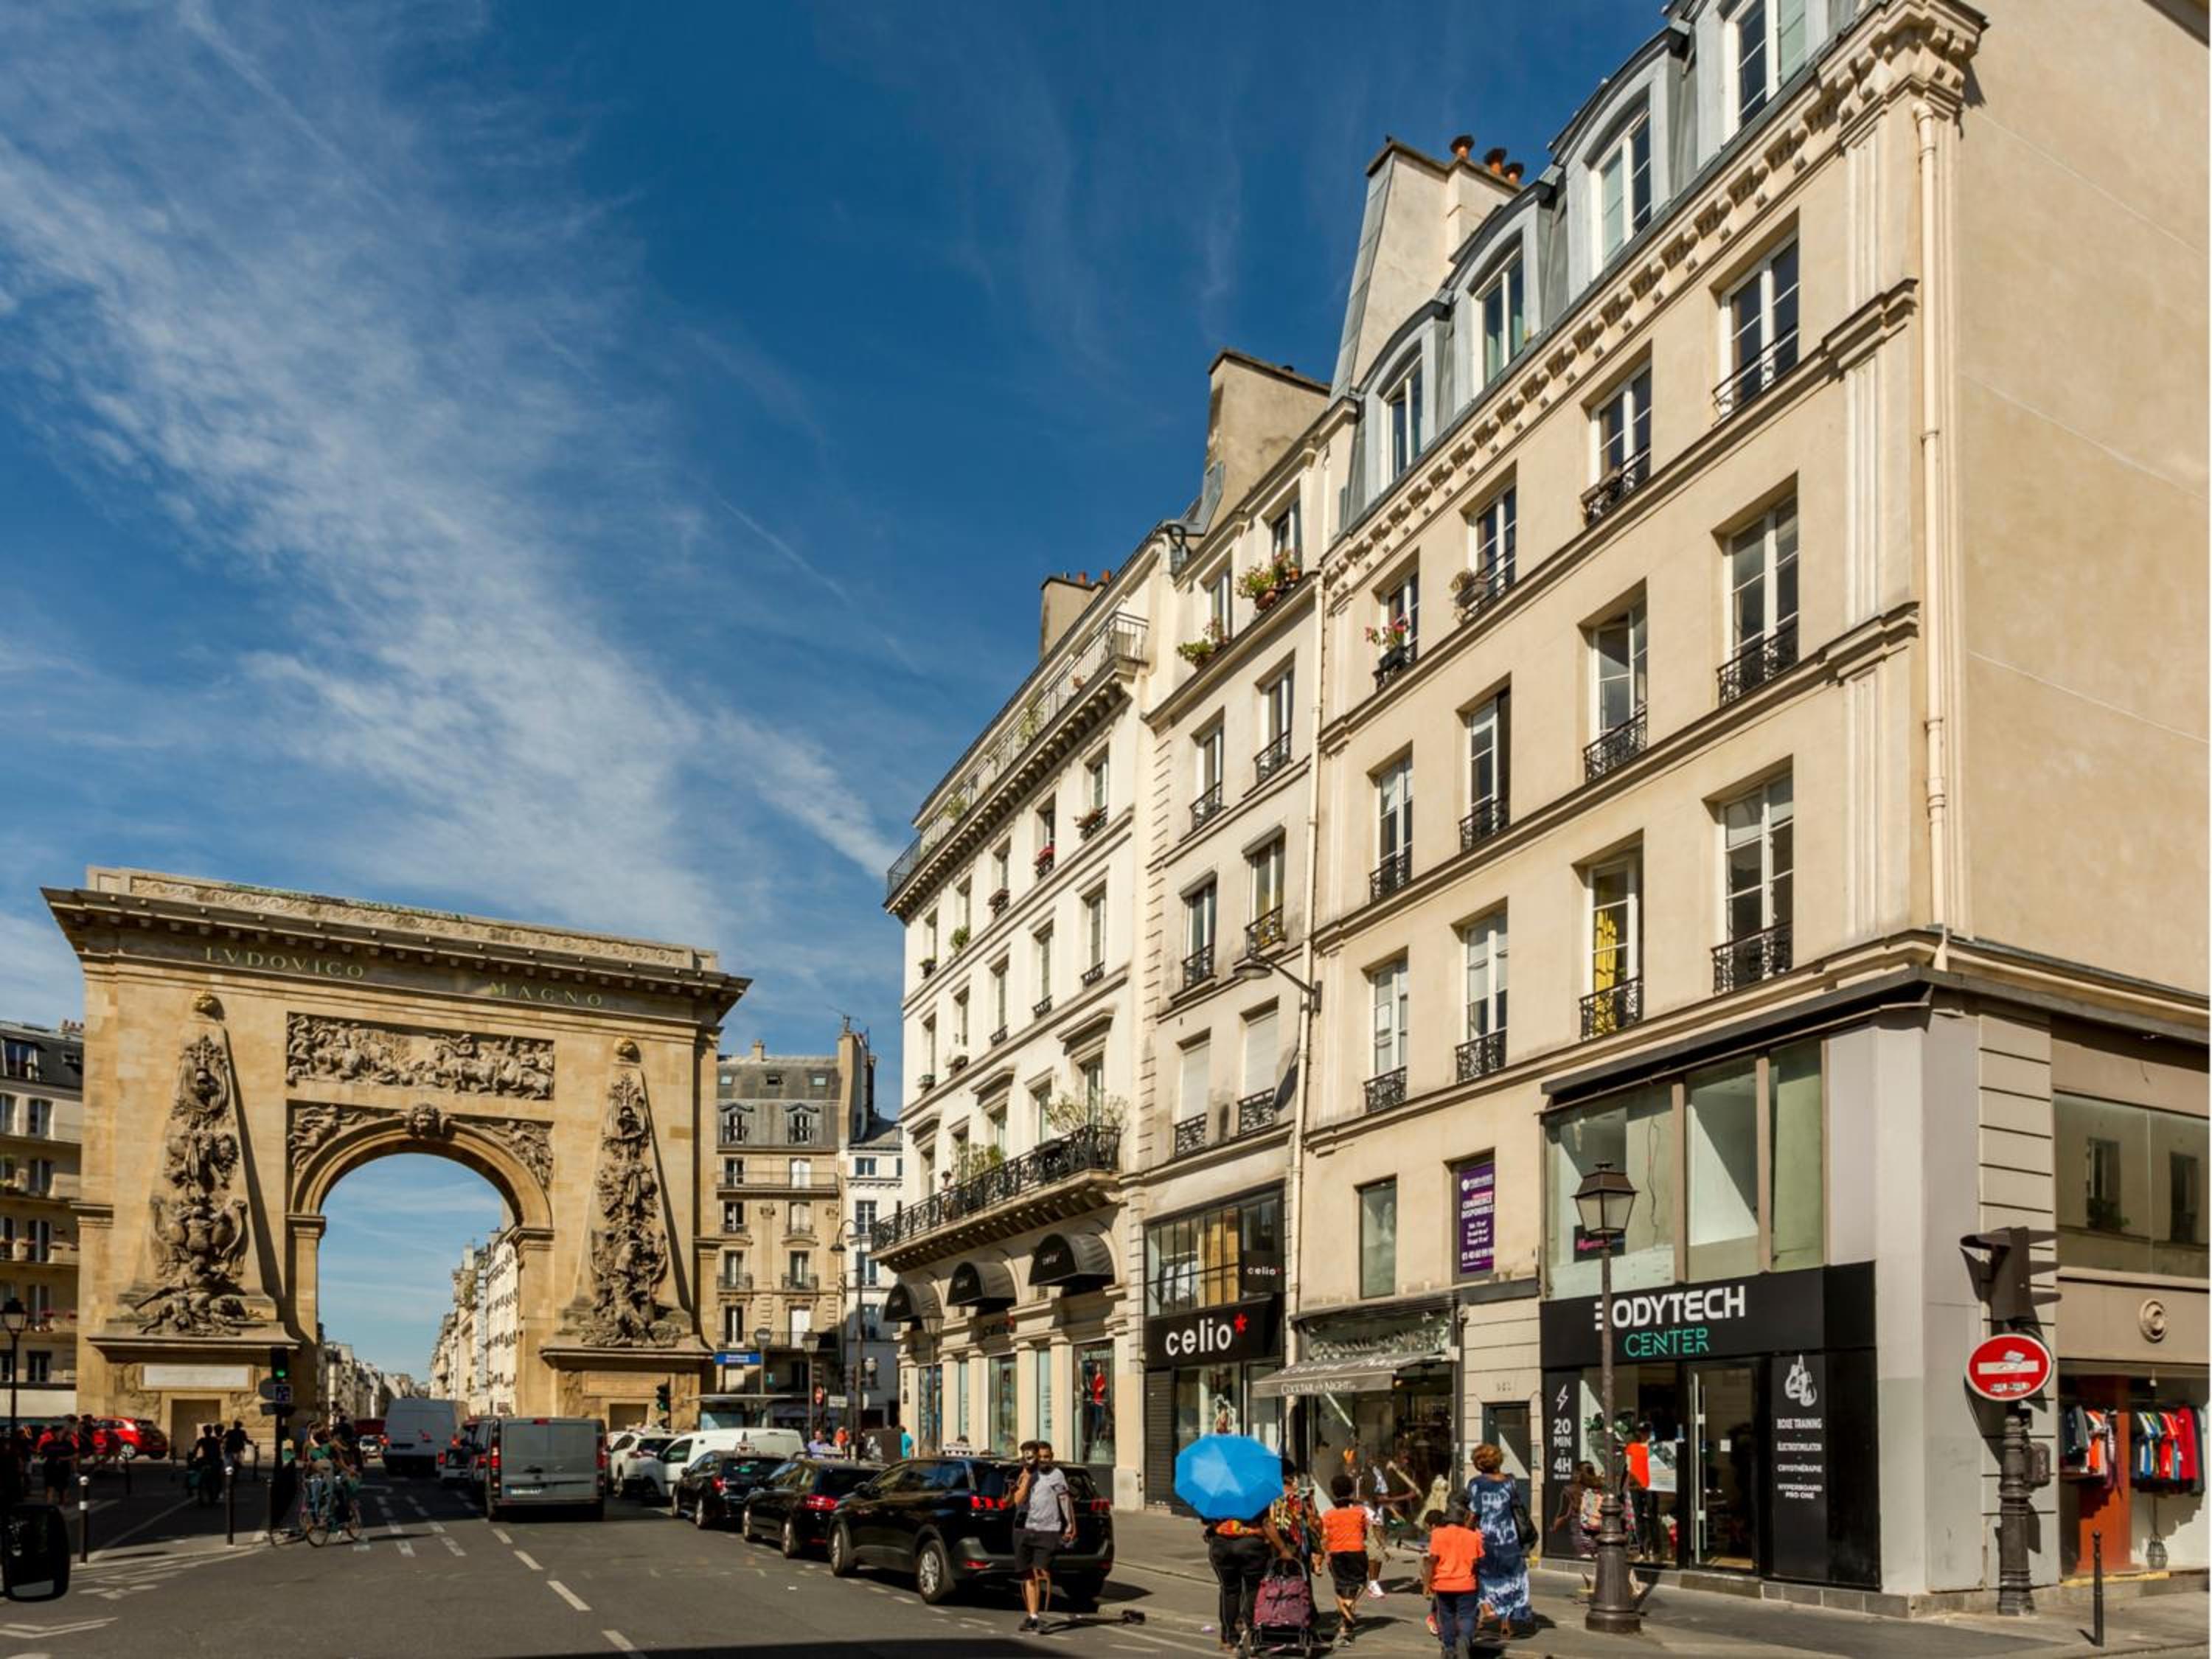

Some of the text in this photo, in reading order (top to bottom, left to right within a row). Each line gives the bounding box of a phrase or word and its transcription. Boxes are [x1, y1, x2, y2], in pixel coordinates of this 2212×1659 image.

[205, 947, 602, 1006] LVDOVICO MAGNO
[1624, 1327, 1710, 1357] CENTER
[1553, 1418, 1572, 1435] 20
[1553, 1436, 1572, 1447] MIN
[1553, 1457, 1572, 1473] 4H
